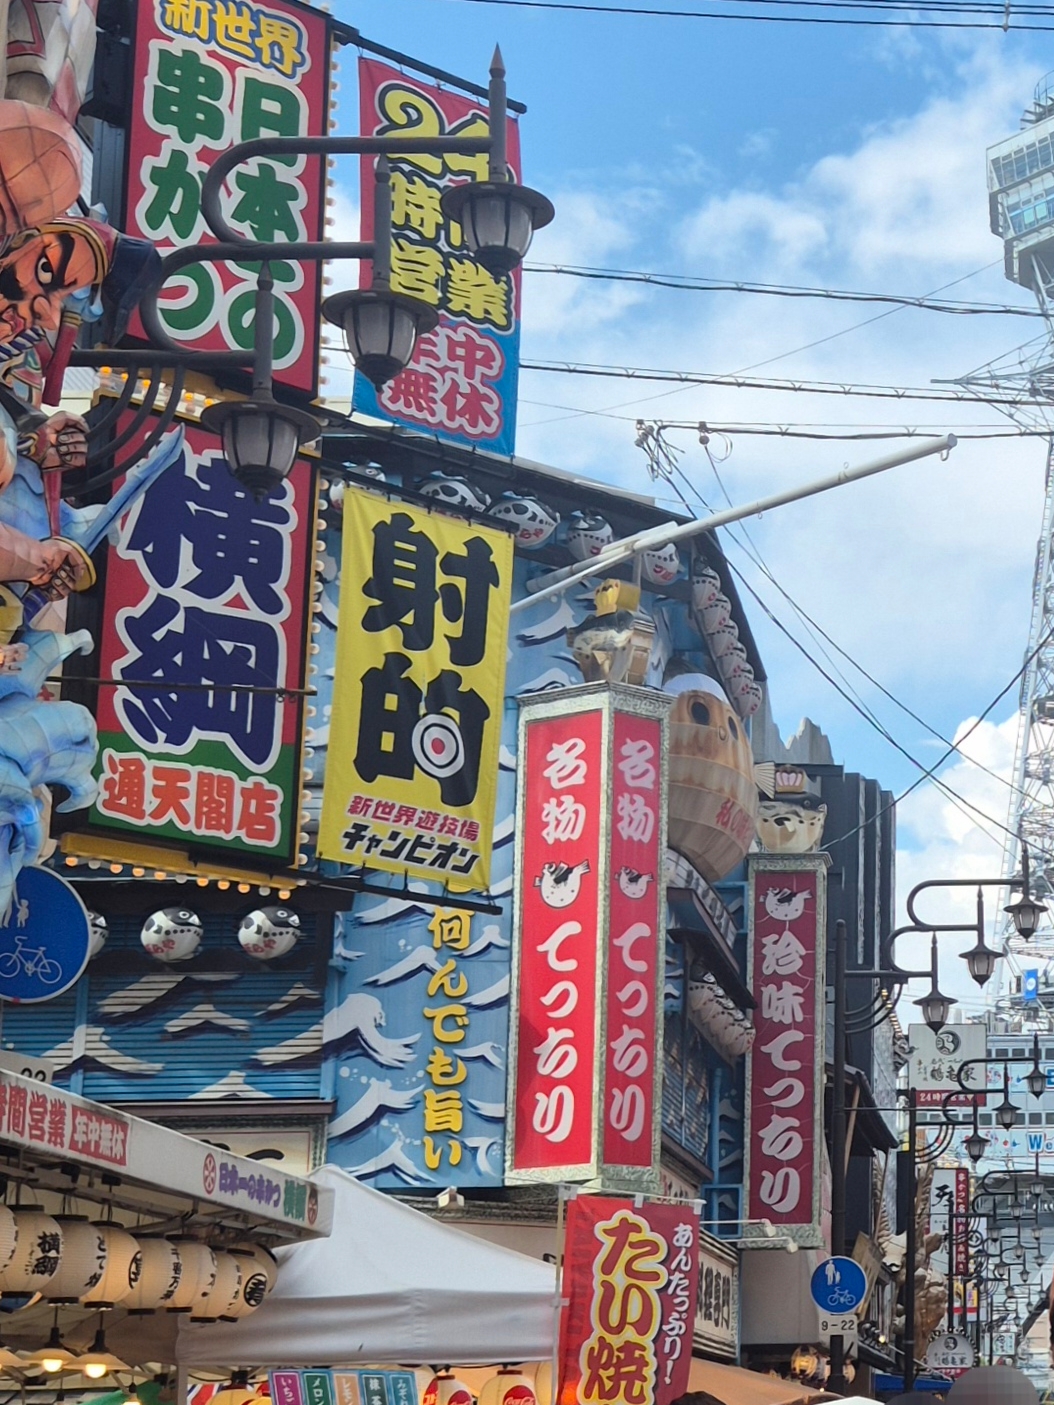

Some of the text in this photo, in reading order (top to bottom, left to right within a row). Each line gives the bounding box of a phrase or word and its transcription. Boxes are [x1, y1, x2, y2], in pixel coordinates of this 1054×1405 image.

[163, 0, 303, 77] 新世界
[145, 48, 226, 332] 串かつ
[387, 369, 502, 431] 無休
[120, 448, 290, 768] 横綱
[352, 511, 501, 807] 射的
[103, 753, 278, 844] 通天閣店
[346, 795, 480, 843] 新世界遊技場
[540, 737, 588, 845] 名物
[615, 738, 656, 845] 名物
[342, 821, 480, 874] チャンピオン
[821, 1319, 856, 1331] 9-22
